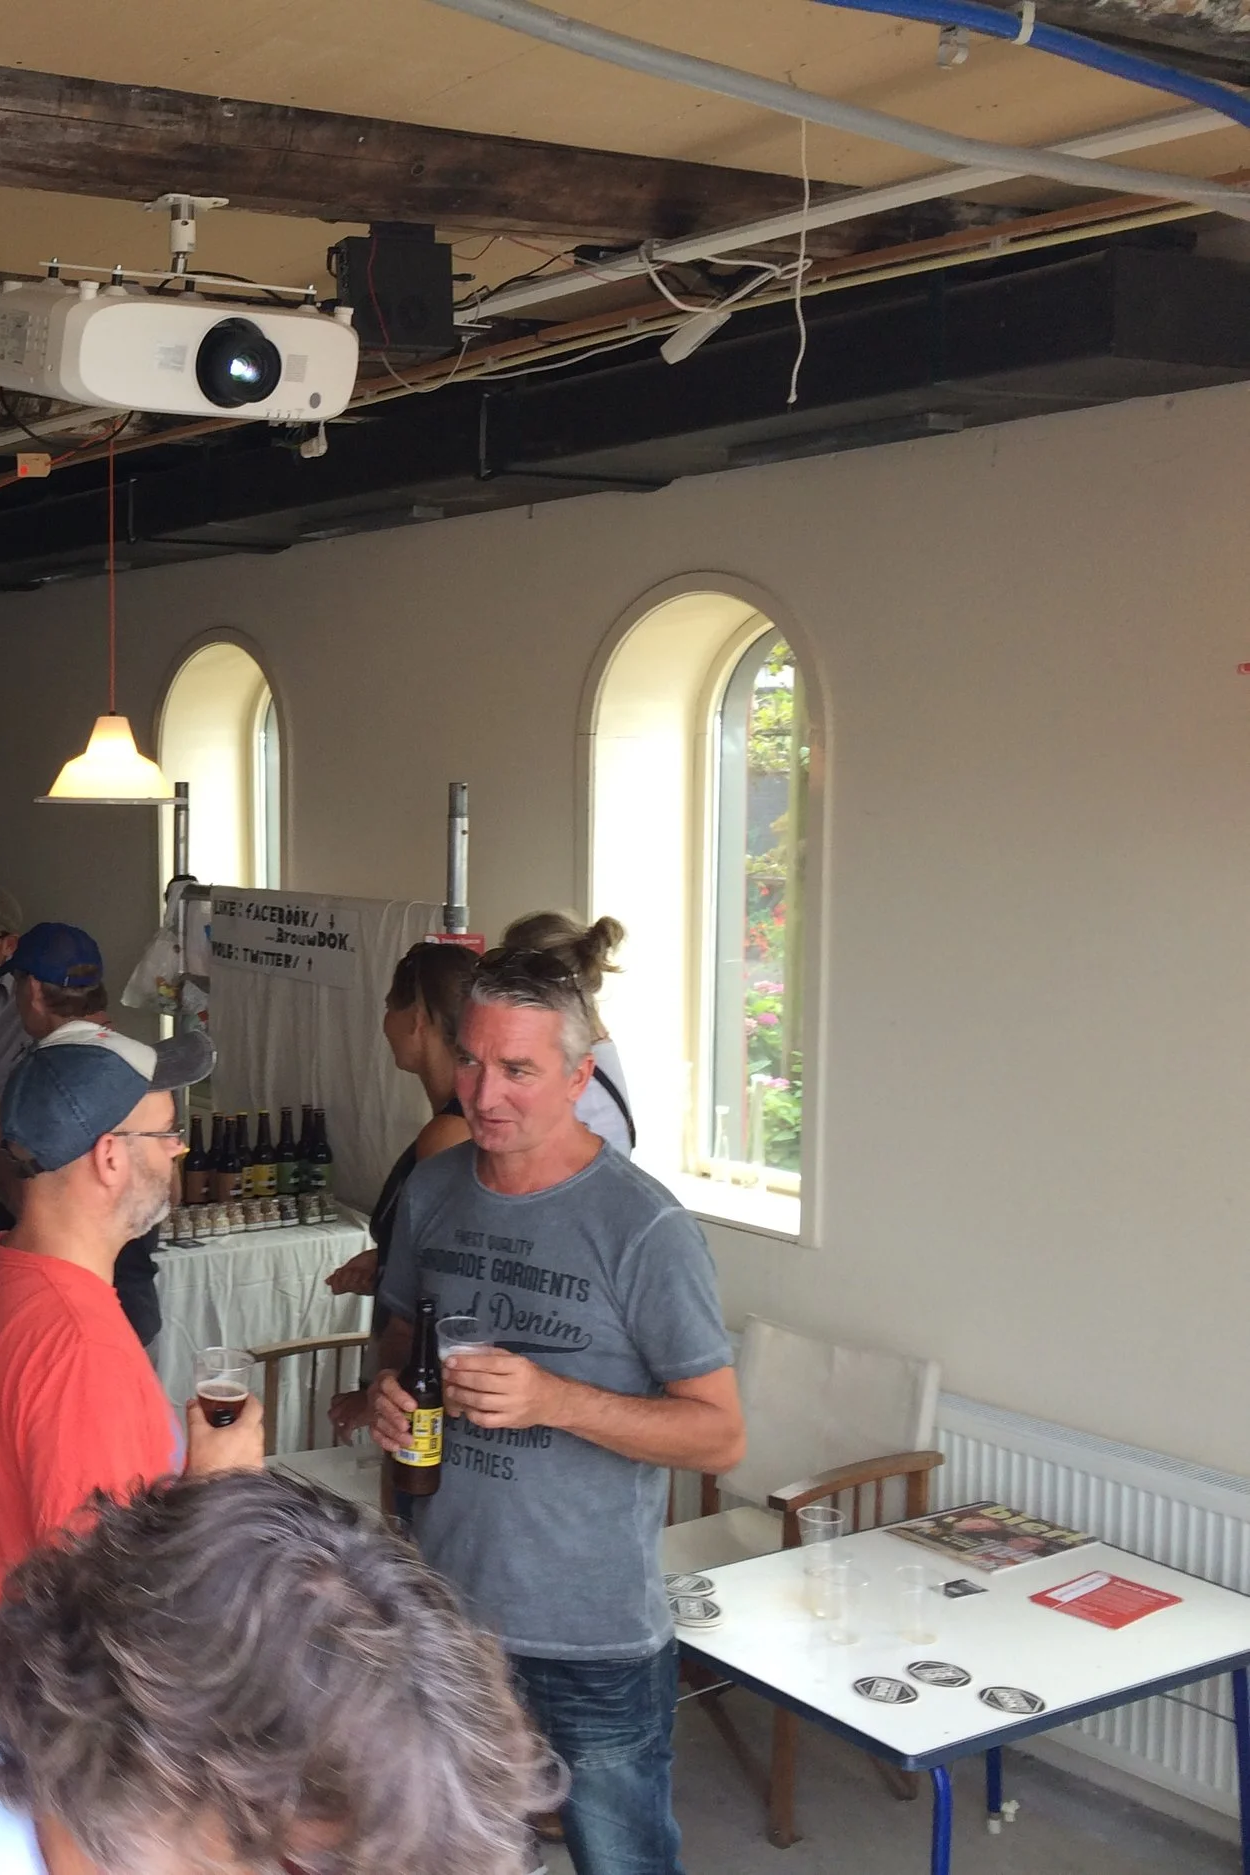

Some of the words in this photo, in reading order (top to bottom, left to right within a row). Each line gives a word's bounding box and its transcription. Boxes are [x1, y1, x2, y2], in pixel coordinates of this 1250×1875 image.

[488, 1235, 534, 1256] QUALITY
[490, 1258, 591, 1302] GARMENTS
[489, 1292, 593, 1345] Denim
